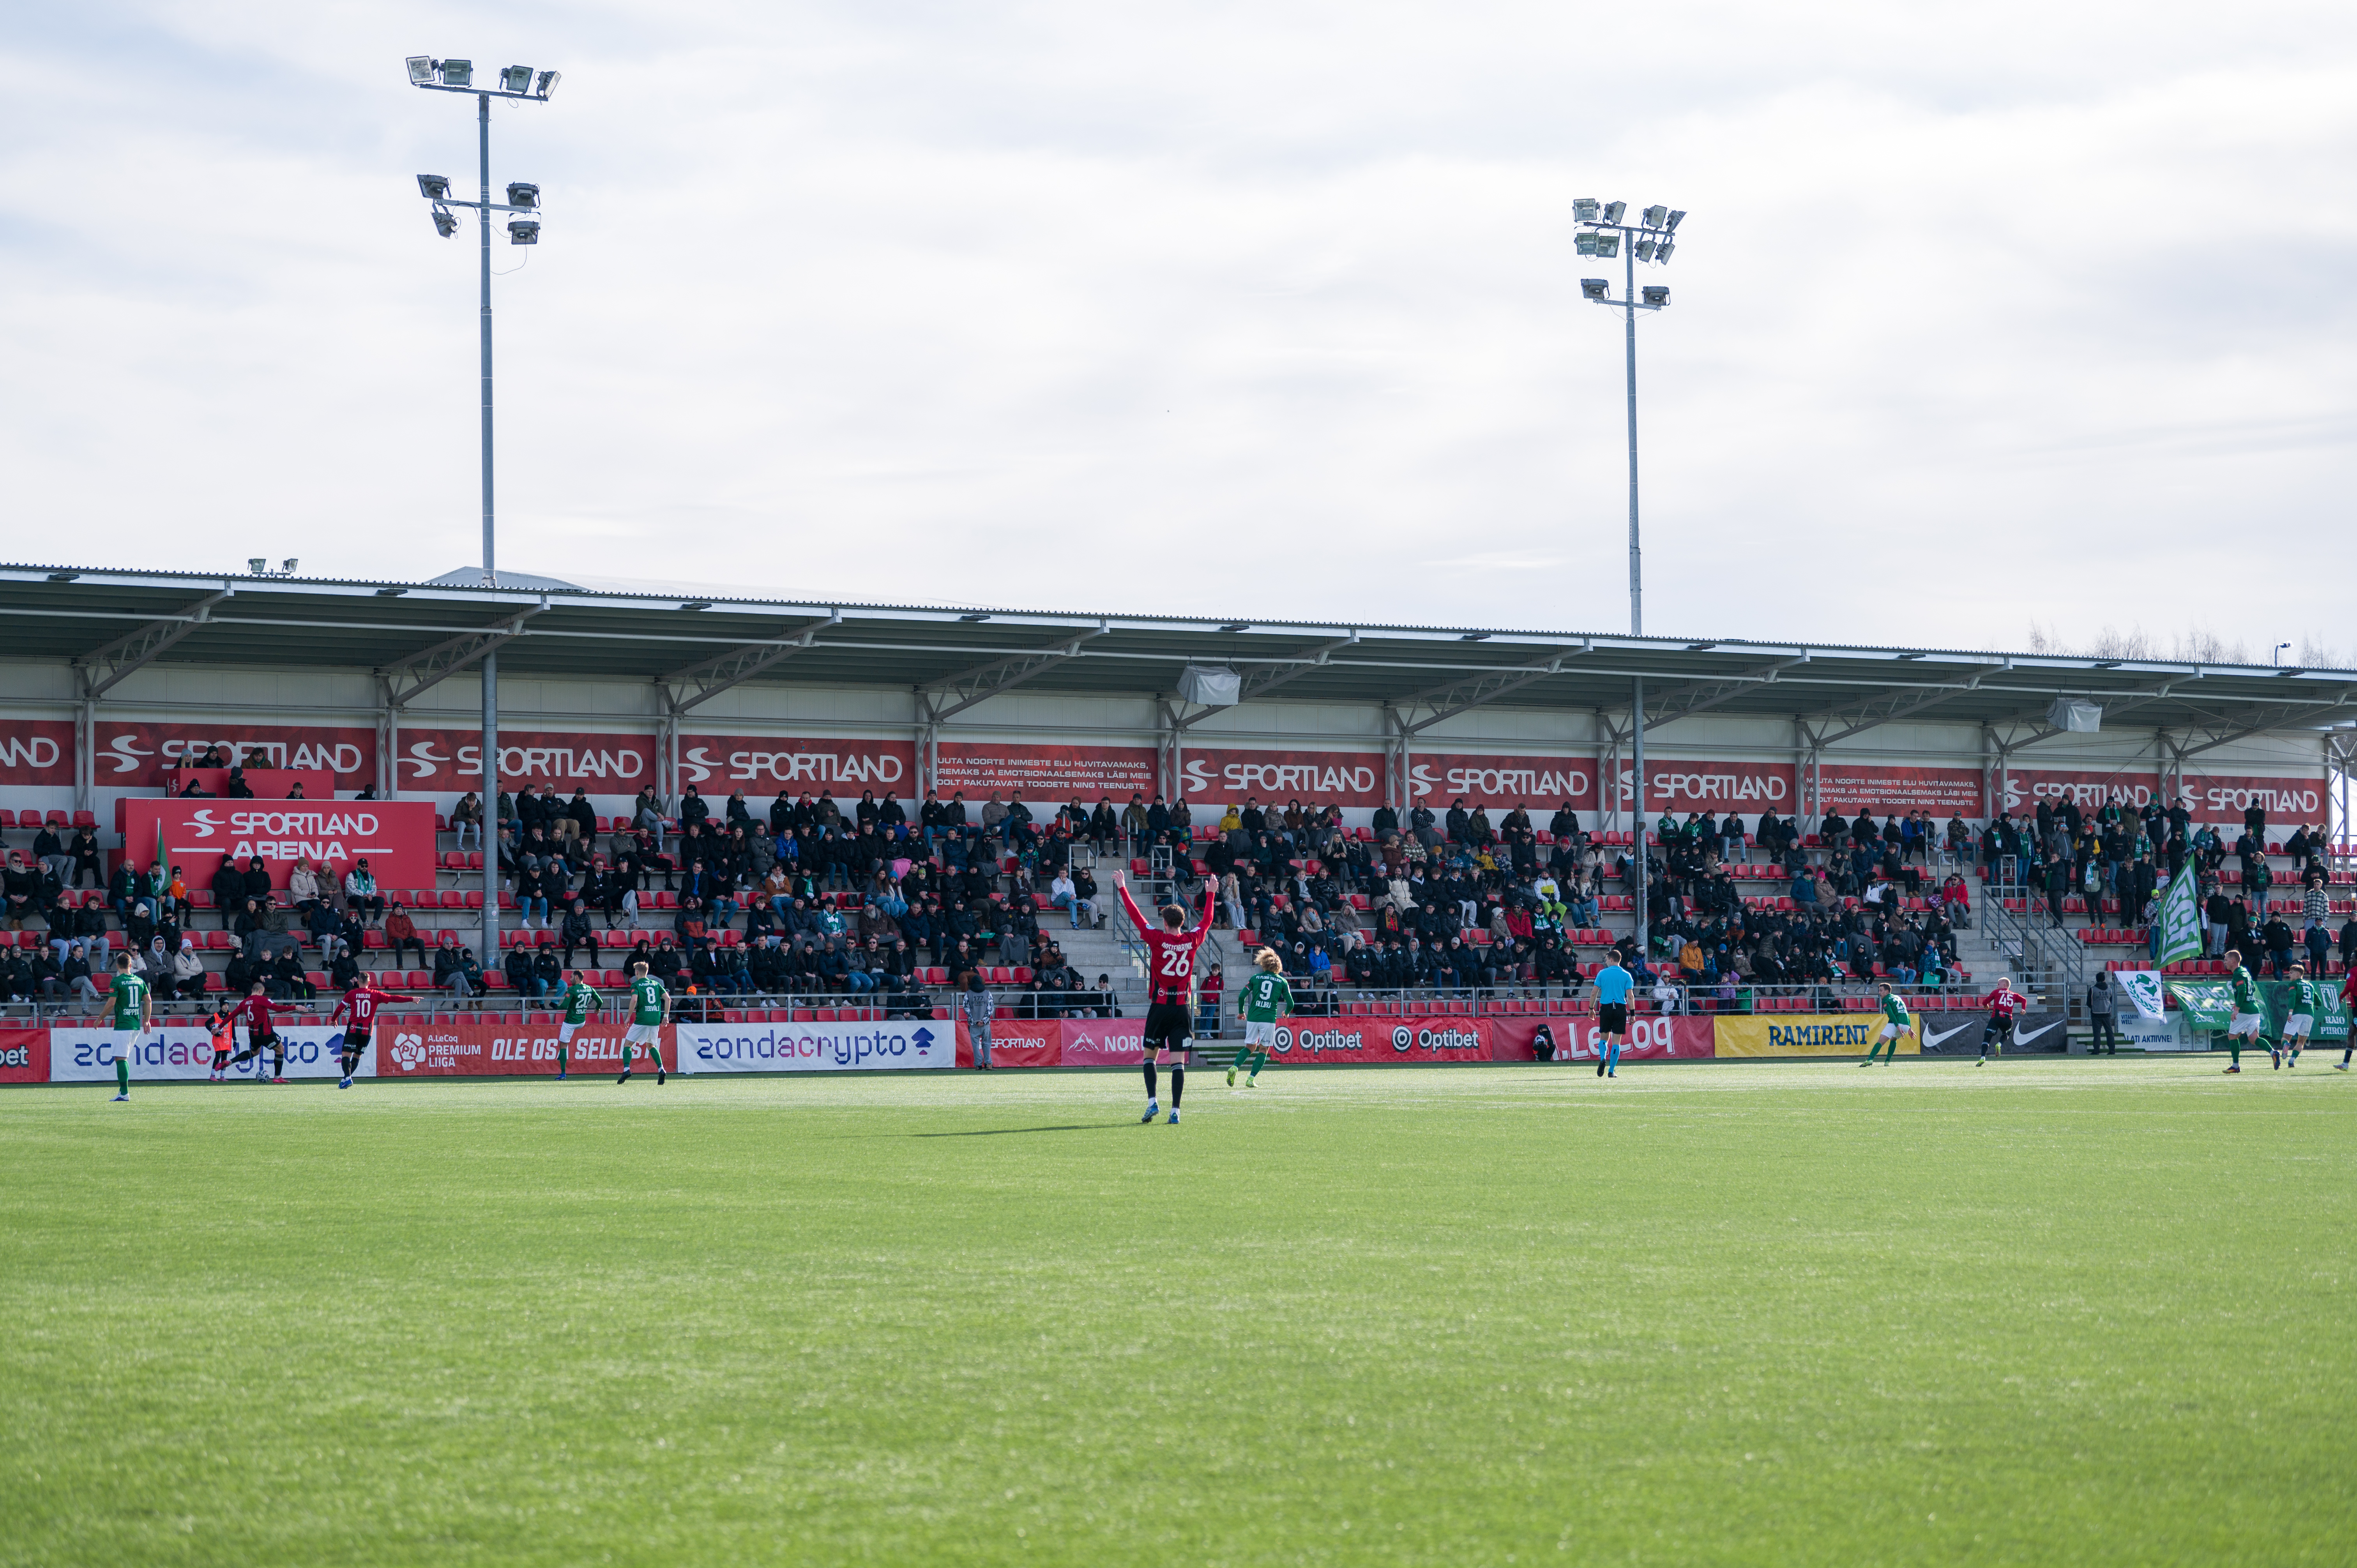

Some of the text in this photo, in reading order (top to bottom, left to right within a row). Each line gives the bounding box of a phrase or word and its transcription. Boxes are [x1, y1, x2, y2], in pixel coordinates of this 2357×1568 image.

[162, 740, 362, 773] SPORTLAND
[457, 746, 643, 778] SORTLAND
[1074, 761, 1148, 770] HUVITAVAMAKS,
[730, 752, 903, 782] SPORTLAND
[998, 770, 1104, 778] EMOTSIONAALSEMAKS
[1224, 764, 1375, 792] SPORTLAND
[1447, 768, 1588, 796] SPORTLAND
[1654, 773, 1786, 800] SPORTLAND
[2033, 783, 2150, 808] SPORTLAND
[2207, 788, 2318, 812] SPORTLAND
[231, 812, 378, 835] SPORTLAND
[232, 841, 348, 860] ARENA
[1161, 942, 1193, 952] OOSTENBRINK
[1161, 950, 1189, 976] 26
[128, 986, 139, 1007] 11
[646, 987, 656, 1004] 8
[1259, 980, 1273, 1000] 9
[2302, 986, 2311, 999] 5
[356, 999, 371, 1017] 10
[575, 993, 592, 1008] 20
[1998, 994, 2013, 1007] 45
[247, 1006, 254, 1021] 6
[2325, 1016, 2345, 1024] RAIO
[428, 1035, 458, 1044] A.LeCoq
[990, 1038, 1045, 1048] SPORTLAND
[1299, 1029, 1362, 1052] Optibet
[1419, 1029, 1479, 1052] Optibet
[1769, 1025, 1869, 1046] RAMIRENT
[401, 1044, 416, 1059] PL
[429, 1045, 481, 1055] PREMIUM
[491, 1038, 528, 1060] OLE
[532, 1038, 569, 1060] OS
[697, 1029, 906, 1065] zondacrypto
[429, 1057, 456, 1067] LIIGA
